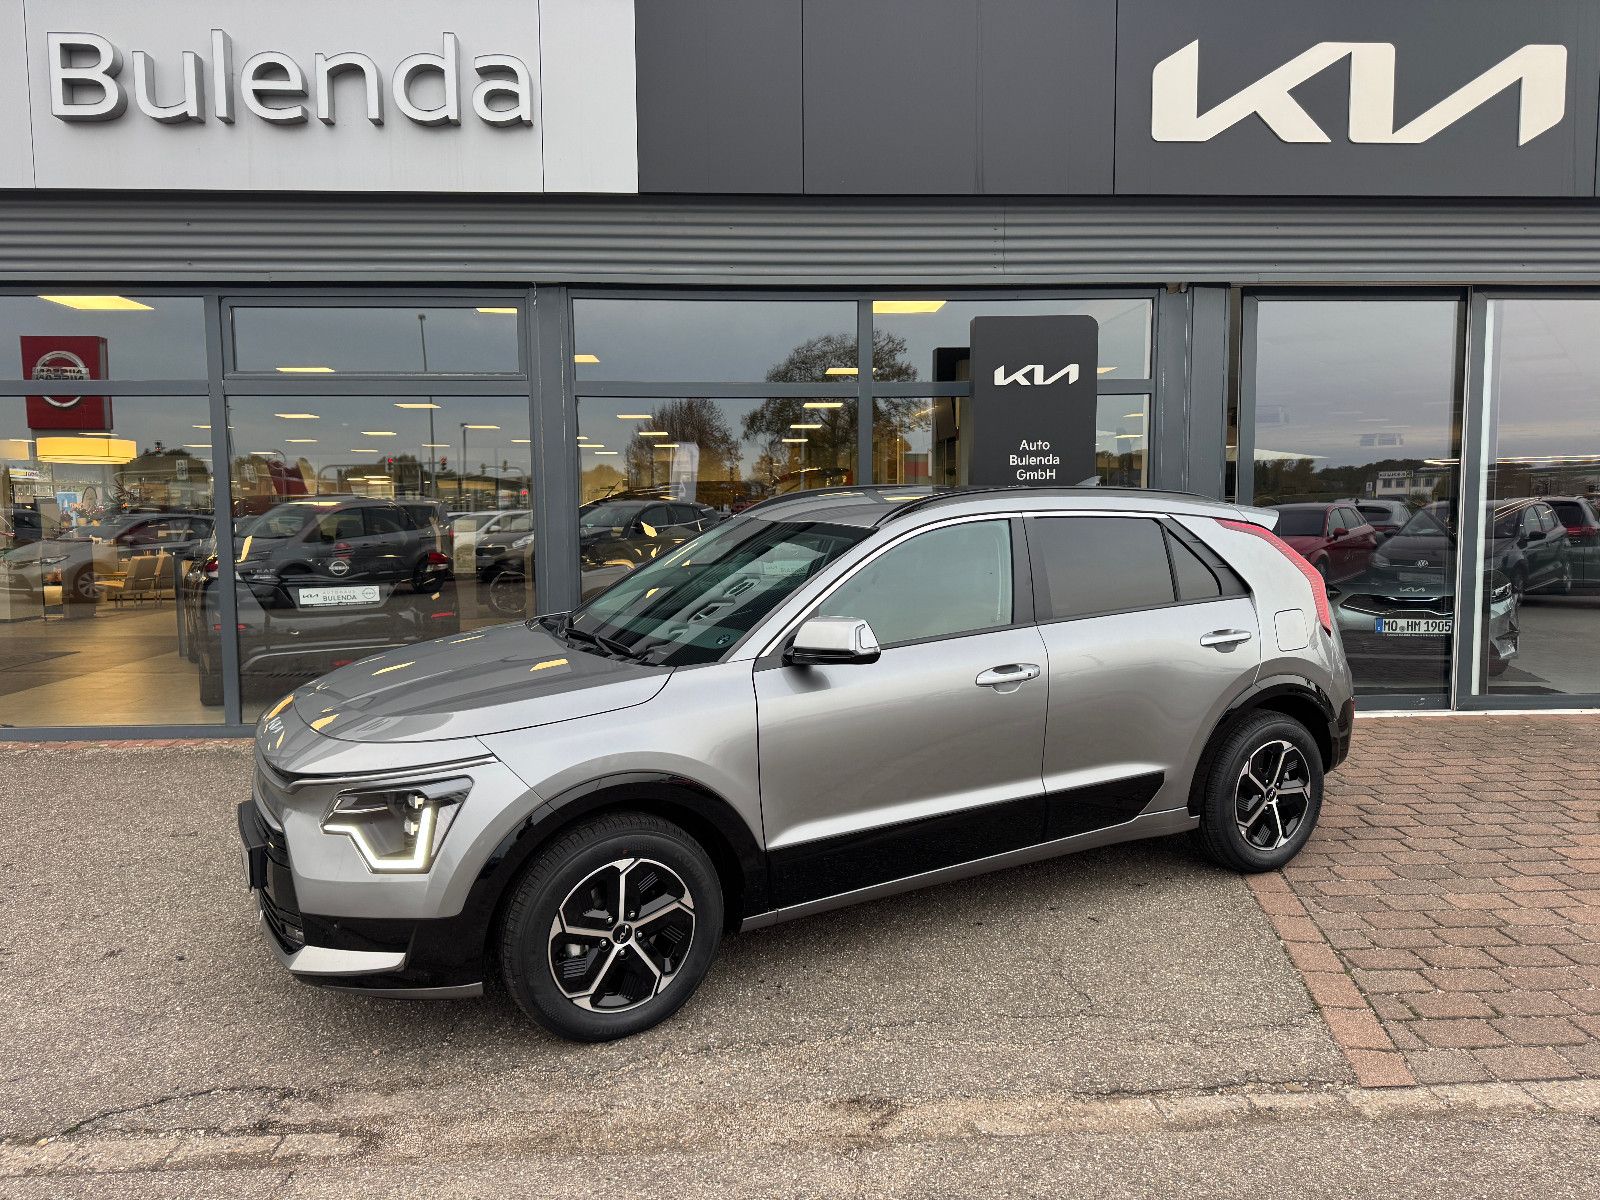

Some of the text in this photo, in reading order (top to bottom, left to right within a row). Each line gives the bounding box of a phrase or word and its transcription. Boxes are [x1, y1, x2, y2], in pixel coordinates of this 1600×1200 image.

[47, 29, 533, 126] Bulenda
[1019, 439, 1050, 451] Auto
[1009, 454, 1060, 466] Bulenda
[1016, 469, 1056, 480] GmbH
[322, 594, 357, 602] BULENDA
[1383, 619, 1451, 632] MO HM 1905
